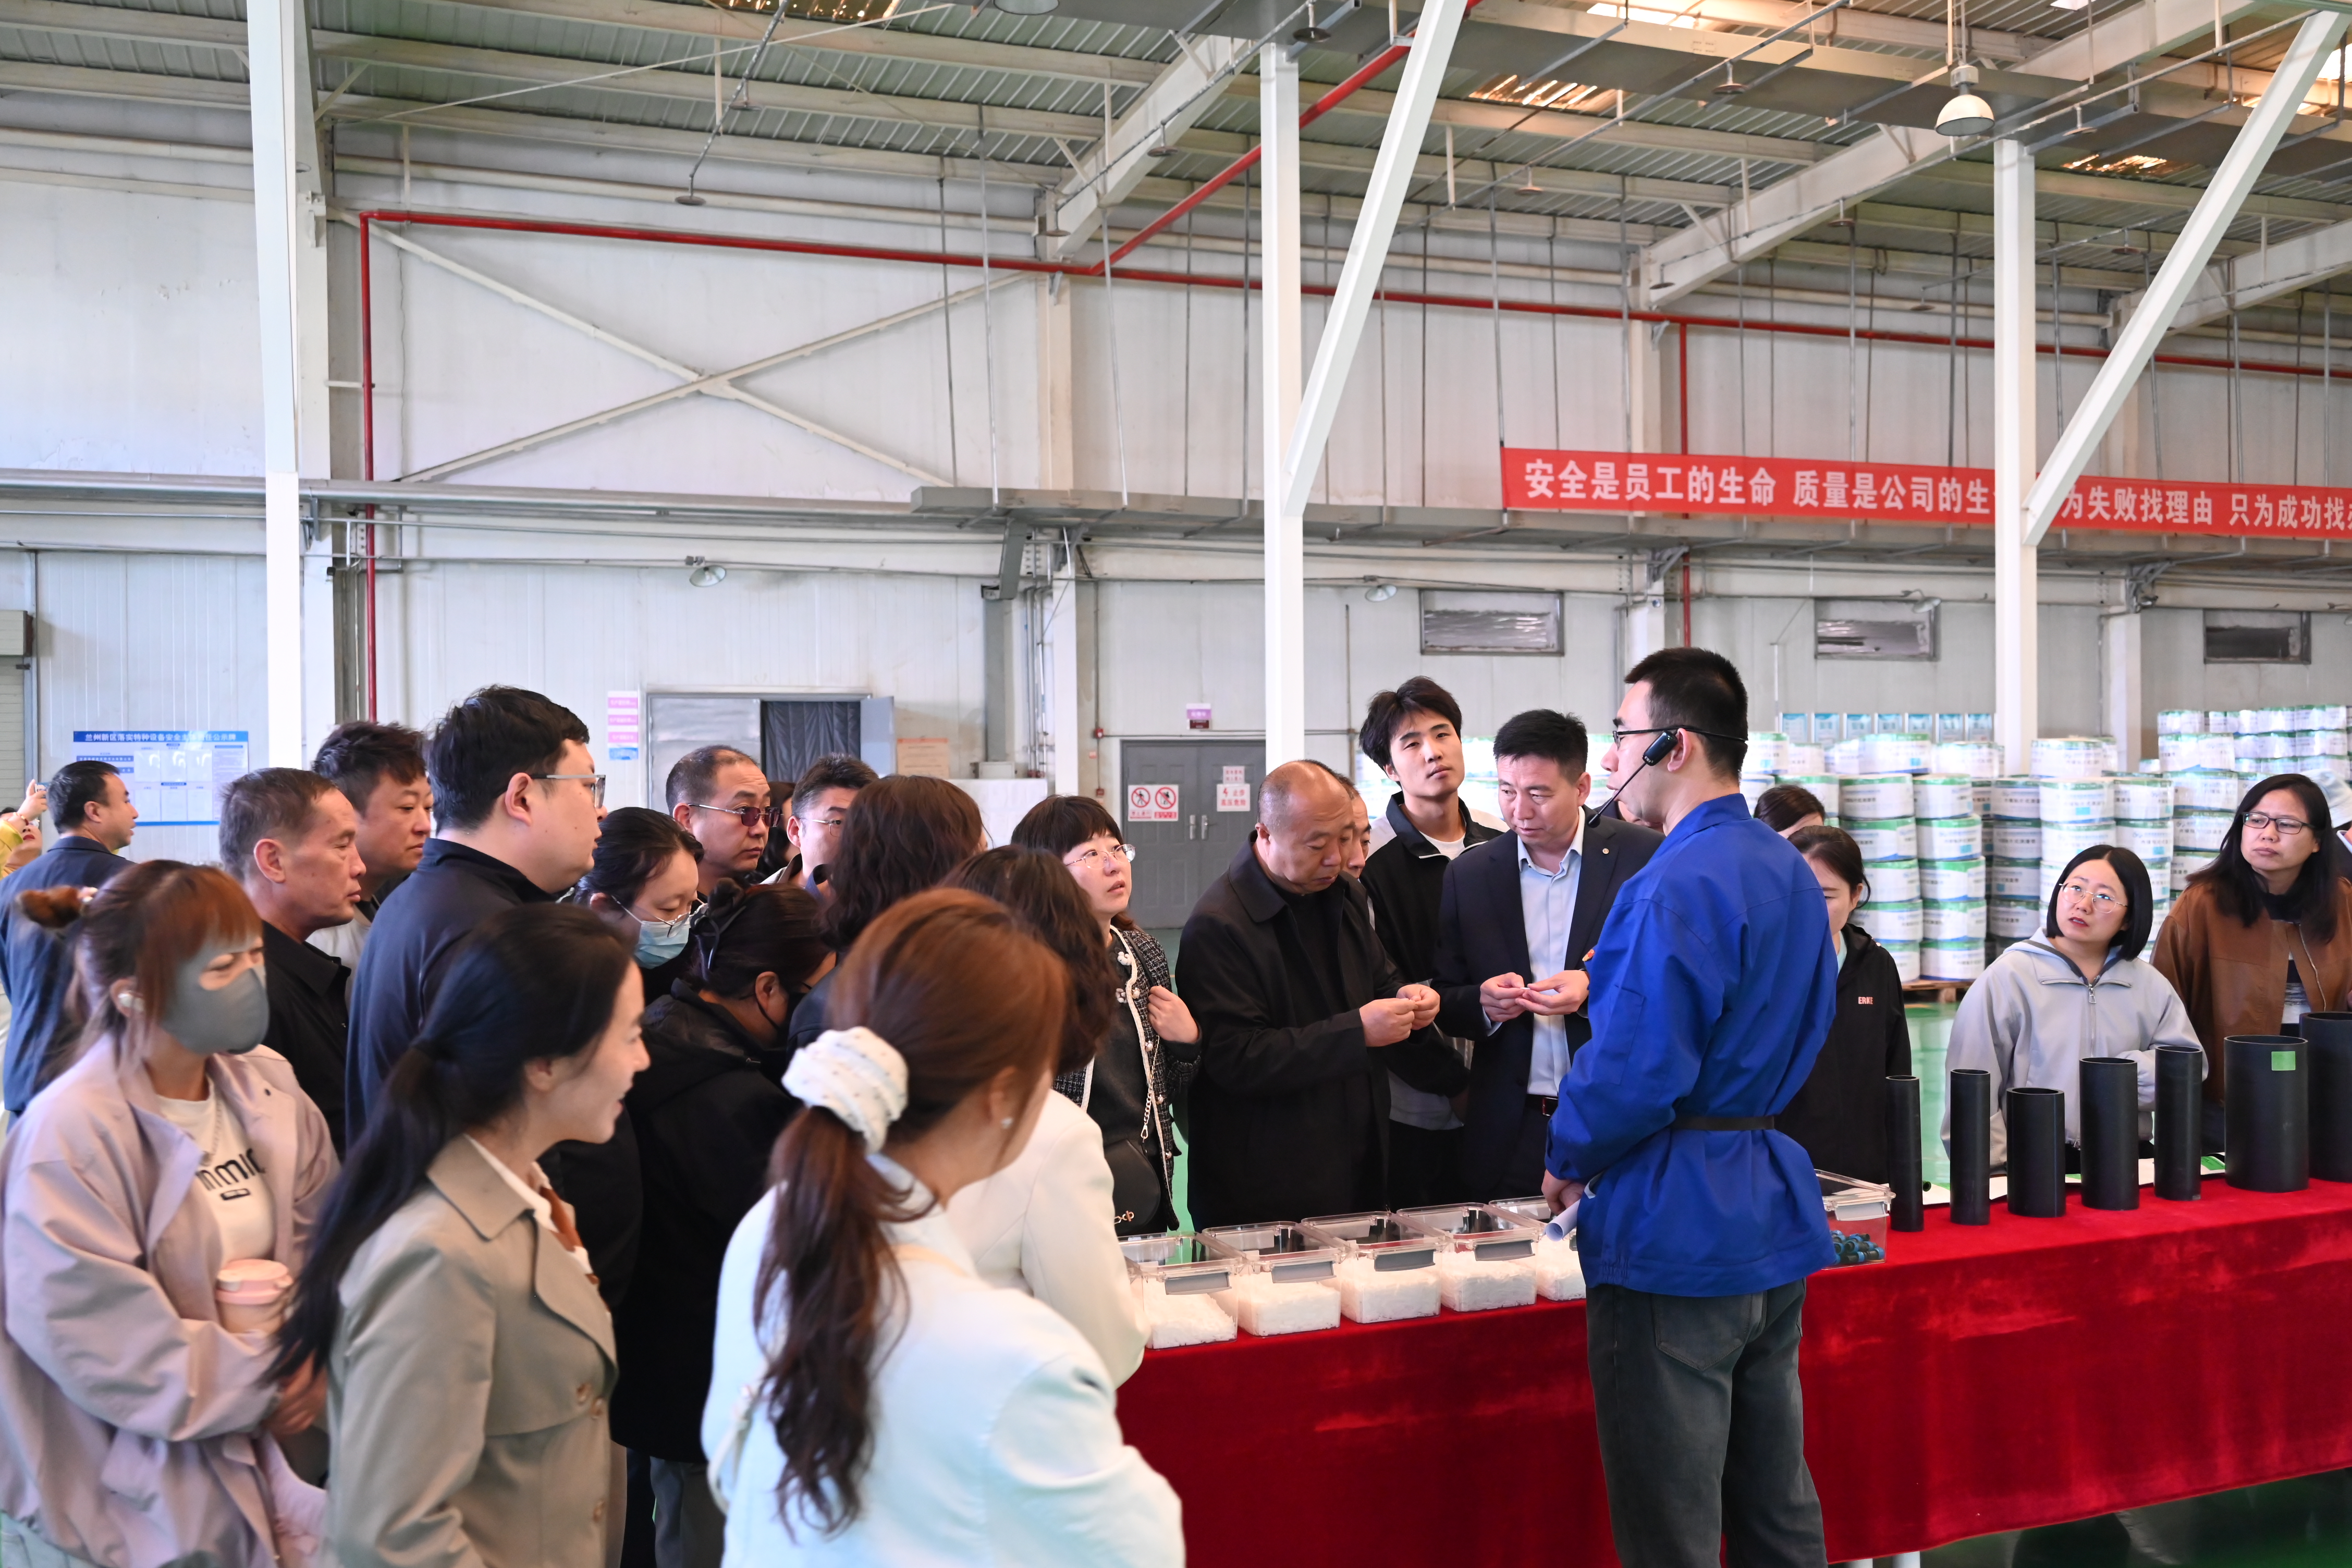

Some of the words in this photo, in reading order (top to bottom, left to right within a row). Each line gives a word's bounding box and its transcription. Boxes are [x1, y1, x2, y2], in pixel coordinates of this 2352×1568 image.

[1524, 458, 1777, 506] 安全是员工的生命
[1793, 470, 1995, 514] 质量是公司的生
[2228, 494, 2352, 531] 只为成功找
[1858, 996, 1873, 1005] ERKE
